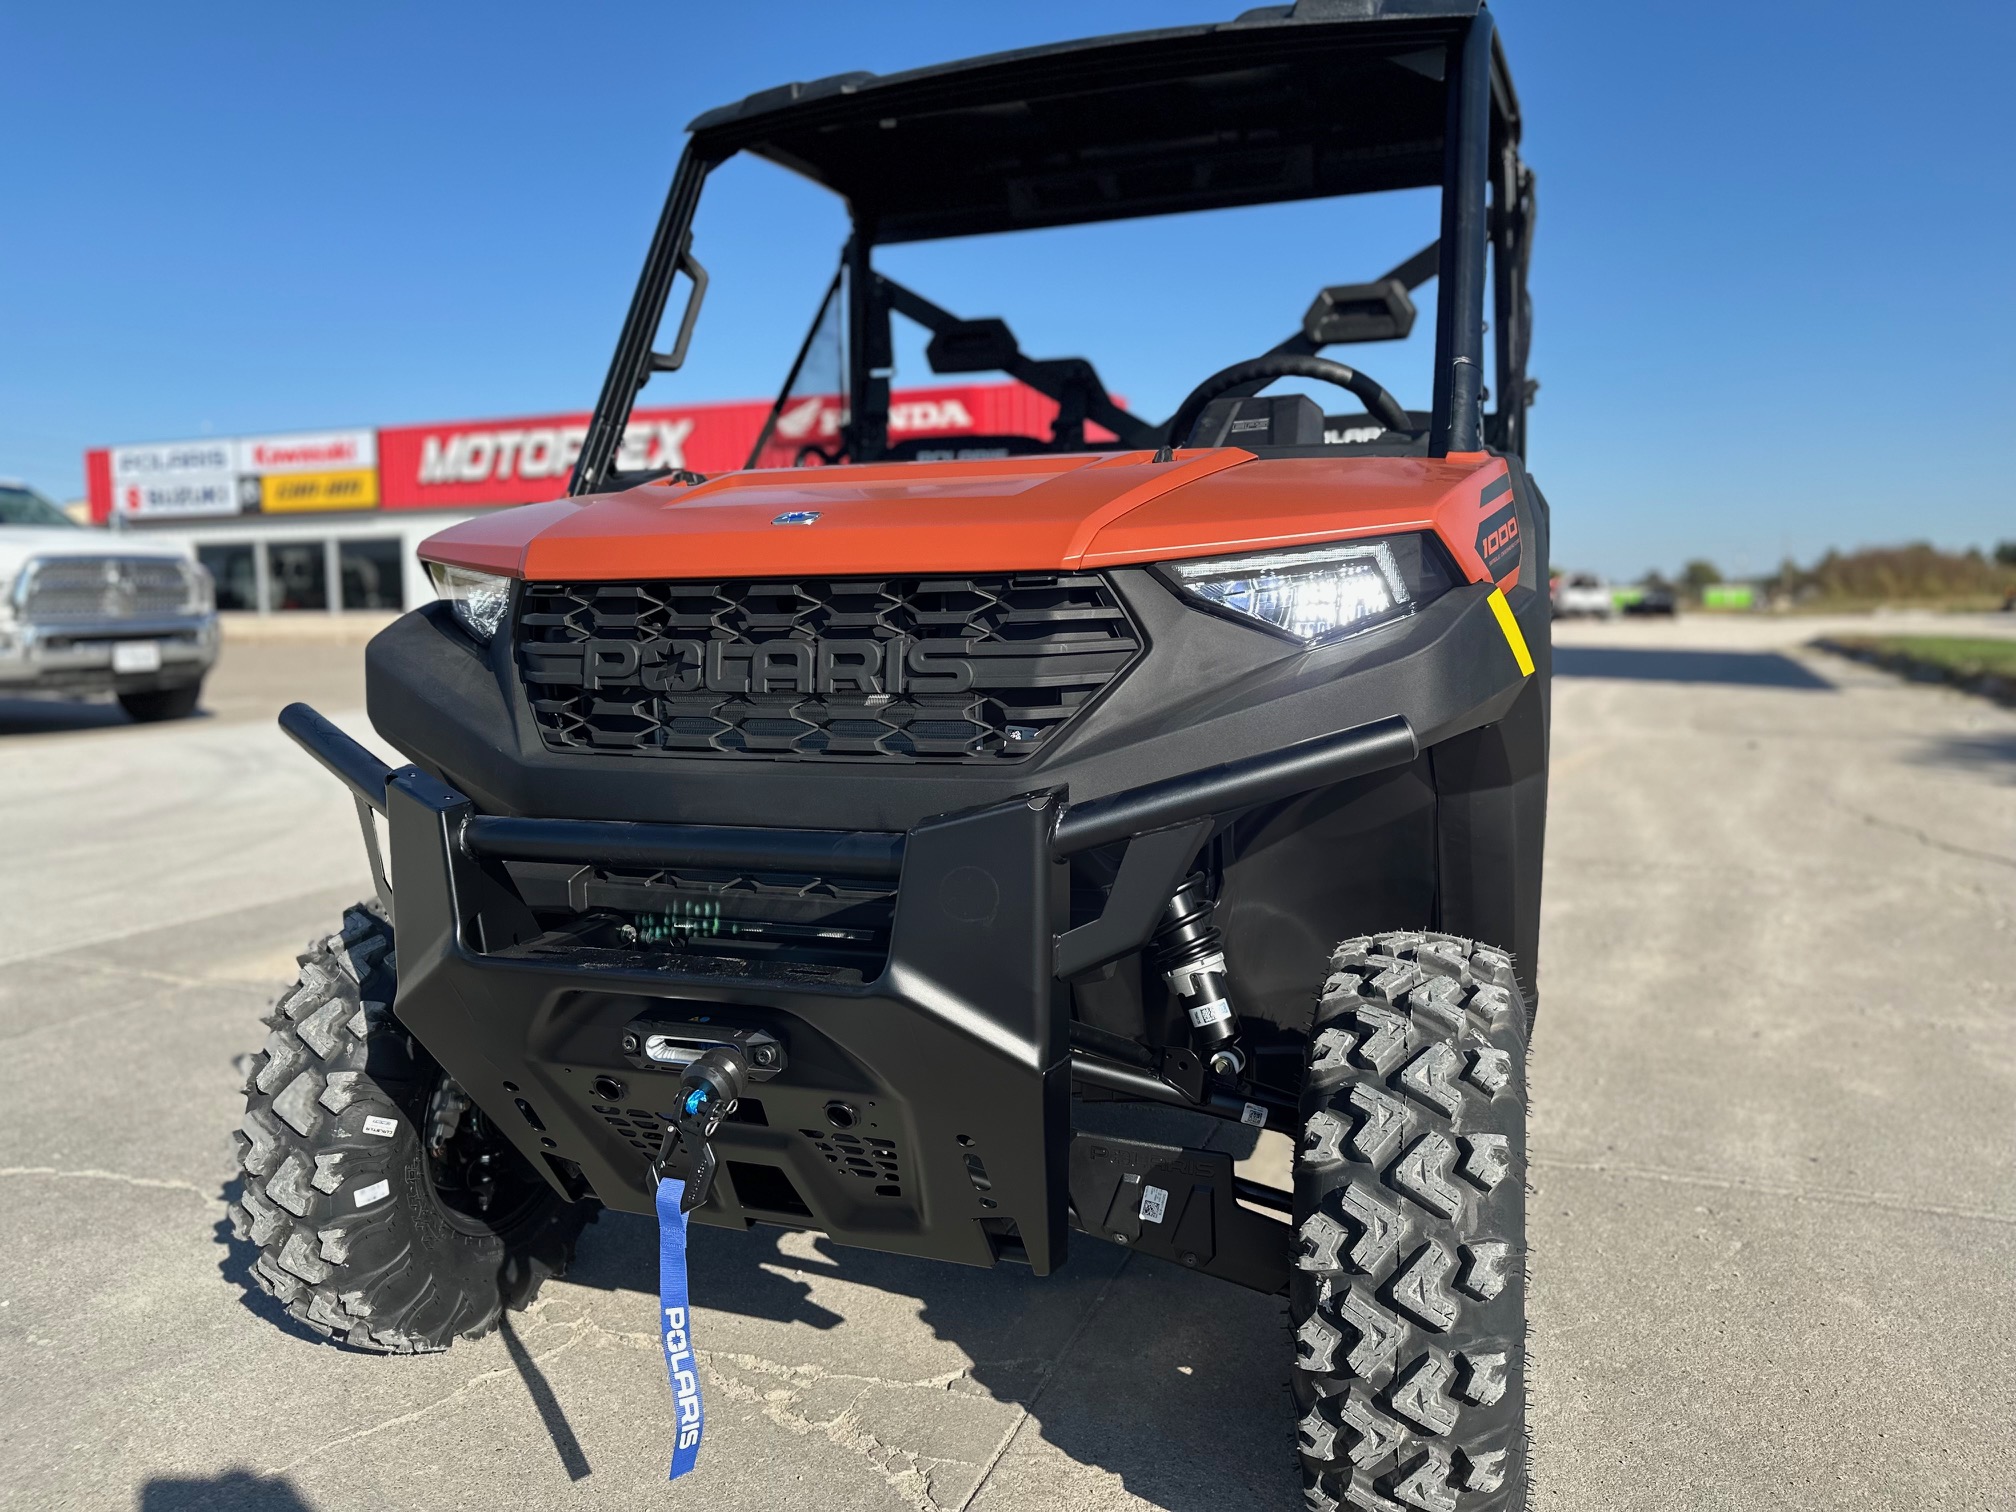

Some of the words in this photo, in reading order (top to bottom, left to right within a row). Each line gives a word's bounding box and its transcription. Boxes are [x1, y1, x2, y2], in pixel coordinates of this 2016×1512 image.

[819, 400, 974, 435] HNDA
[418, 418, 694, 485] MOTOPEX
[1482, 516, 1518, 559] 1000
[583, 638, 977, 693] POLARIS
[665, 1307, 700, 1450] POLARIS
